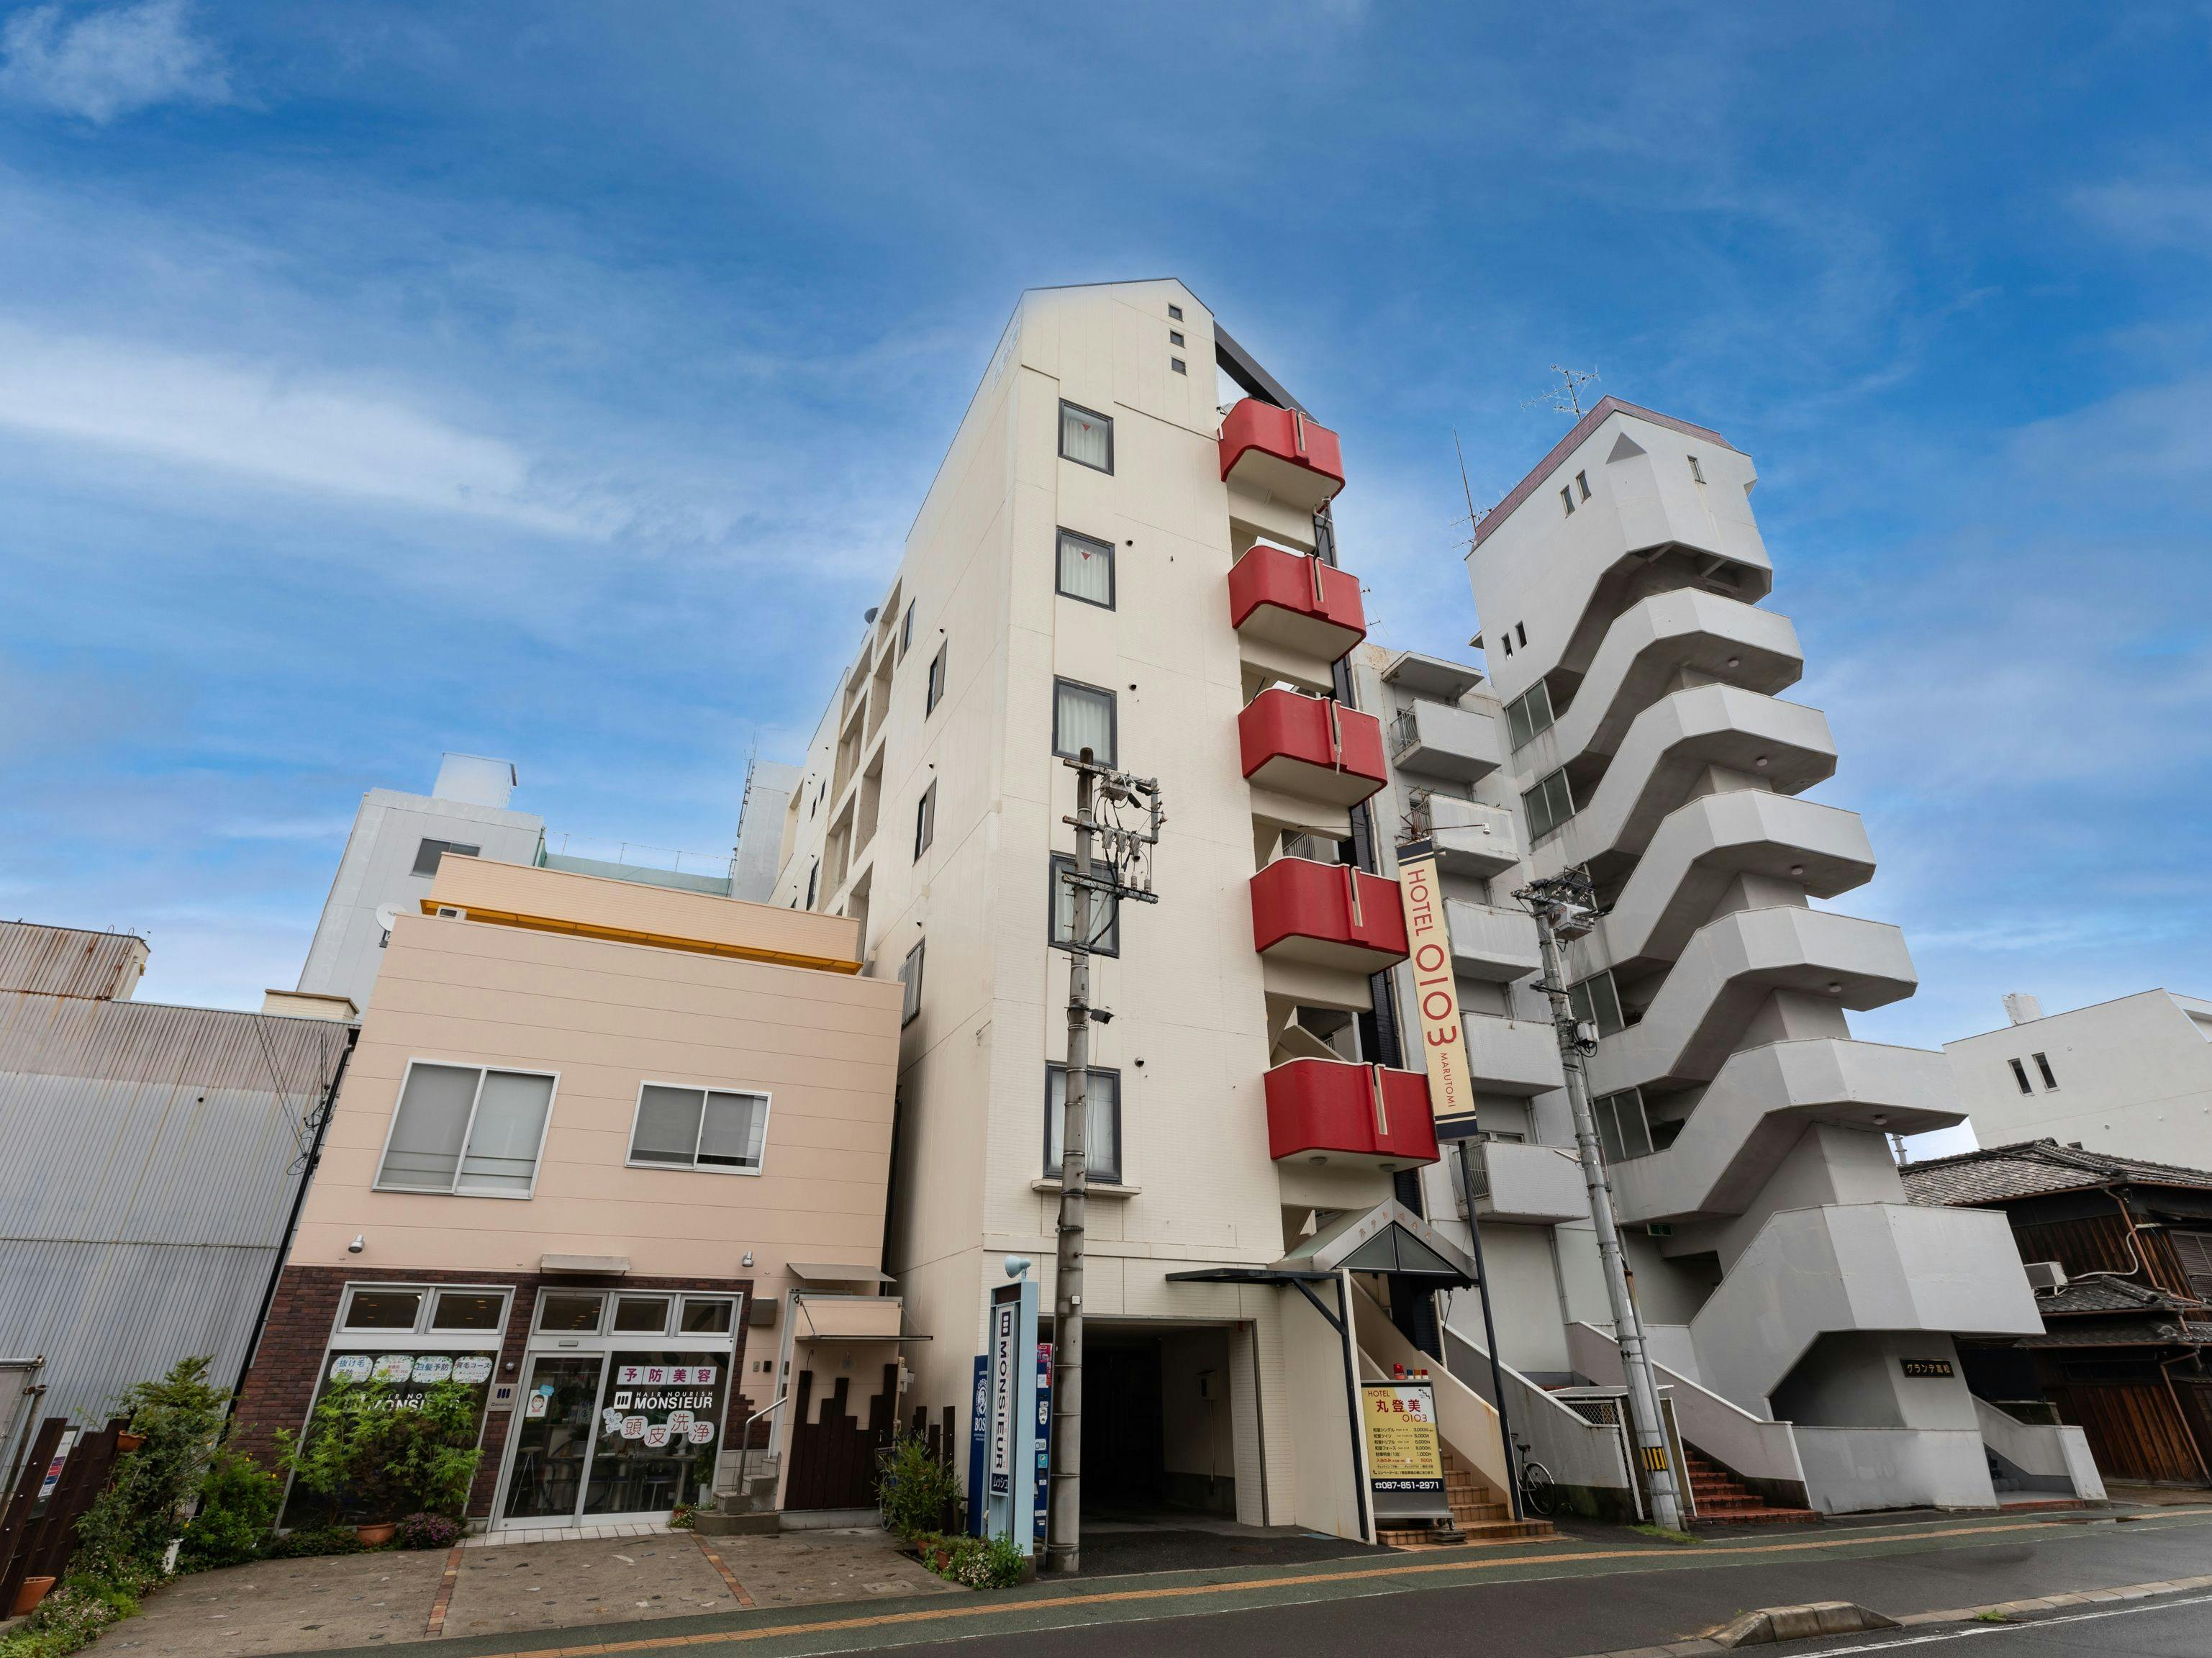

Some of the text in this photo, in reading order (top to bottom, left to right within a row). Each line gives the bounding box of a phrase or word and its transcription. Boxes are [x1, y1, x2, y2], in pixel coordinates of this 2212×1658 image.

[1408, 869, 1433, 937] HOTEL
[1440, 1053, 1456, 1107] MARUTOMI
[338, 1359, 365, 1368] 抜け毛
[417, 1363, 450, 1372] 白髪予防
[624, 1368, 711, 1382] 予防美容
[634, 1397, 713, 1409] MONSIEUR
[996, 1341, 1007, 1469] MONSIEUR
[1376, 1399, 1421, 1413] 丸登美
[624, 1413, 710, 1444] 頭皮洗浄
